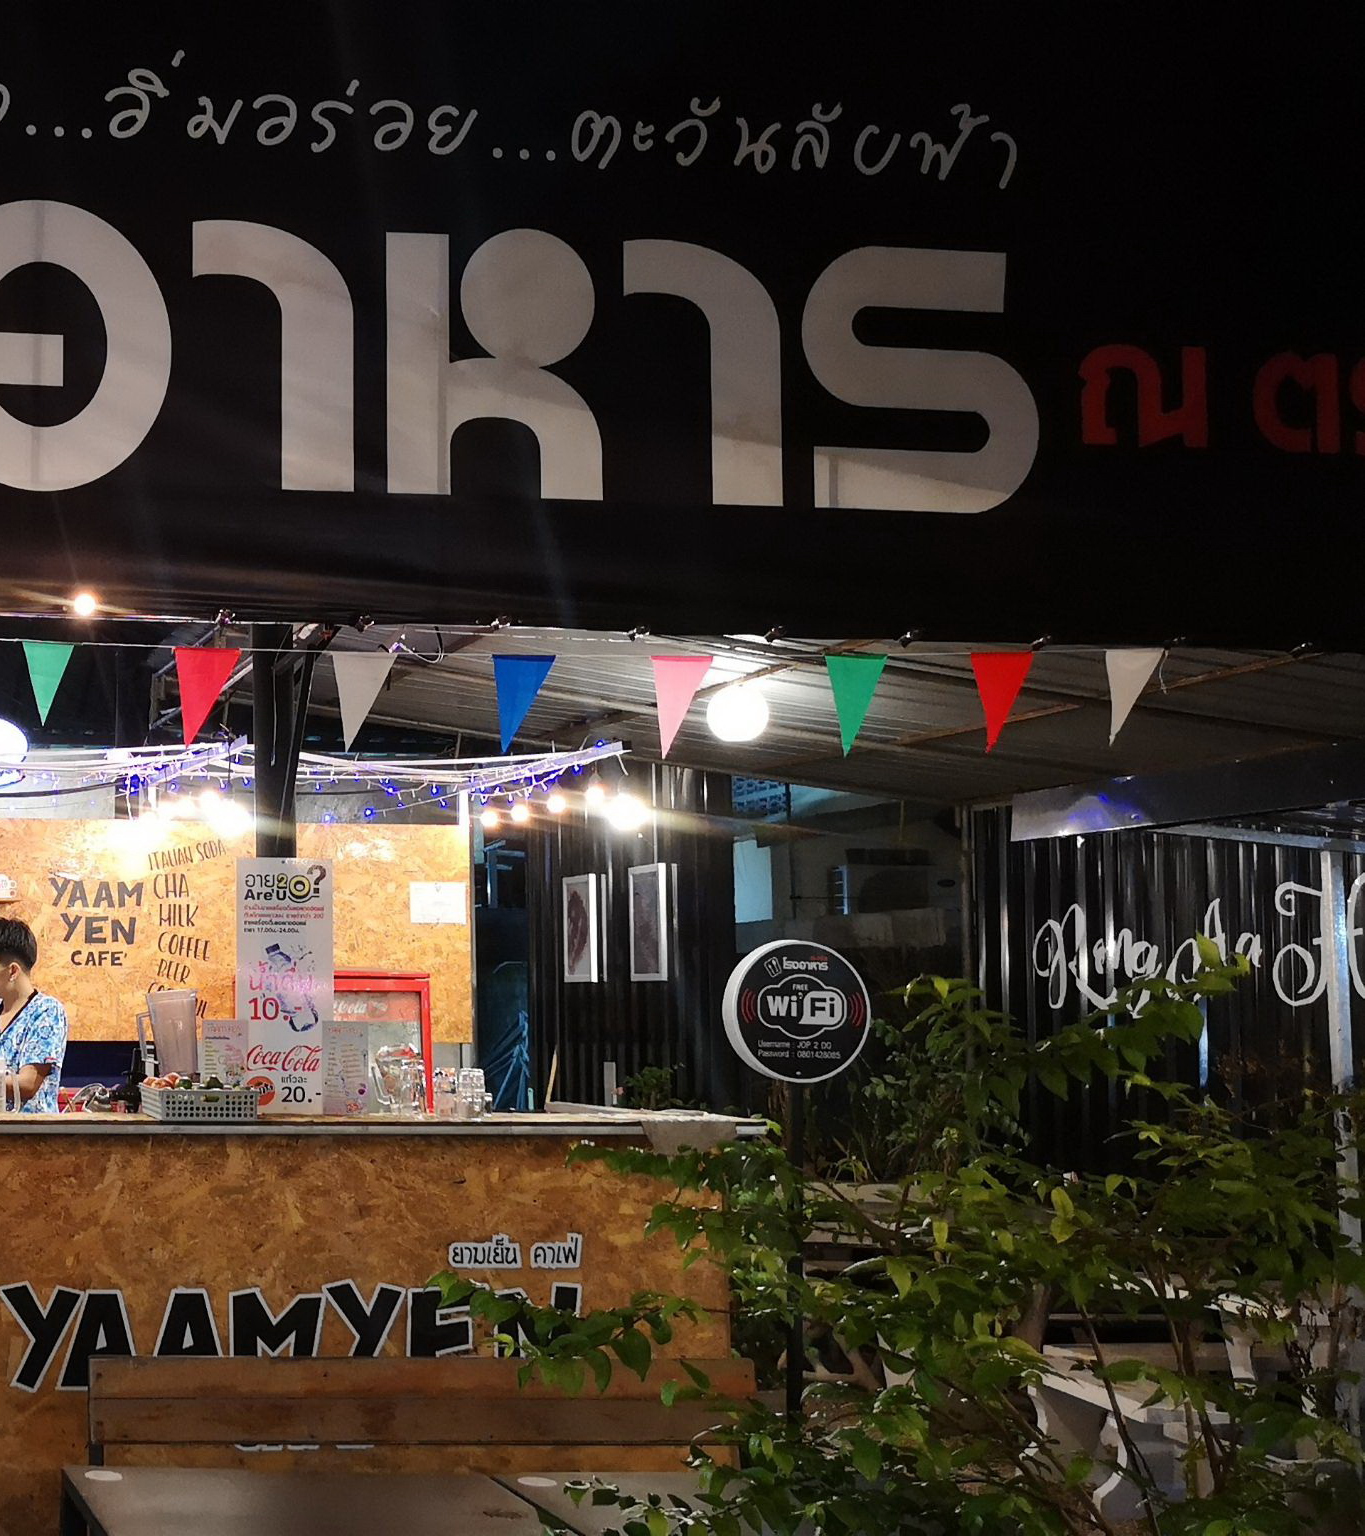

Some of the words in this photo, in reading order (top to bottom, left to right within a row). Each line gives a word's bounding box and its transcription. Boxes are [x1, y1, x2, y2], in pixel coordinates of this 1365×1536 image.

[1078, 344, 1208, 448] ณ
[148, 845, 194, 871] ITALIAN
[196, 839, 227, 859] SODA
[48, 877, 144, 908] YAAM
[153, 873, 190, 899] CHA
[60, 912, 136, 945] YEN
[159, 904, 199, 928] MILK
[158, 931, 211, 961] COFFEE
[157, 958, 191, 985] BEER
[792, 983, 809, 992] FREE
[757, 1049, 790, 1058] Password
[451, 1237, 518, 1265] ยามเย็น
[533, 1236, 579, 1264] คาเฟ่
